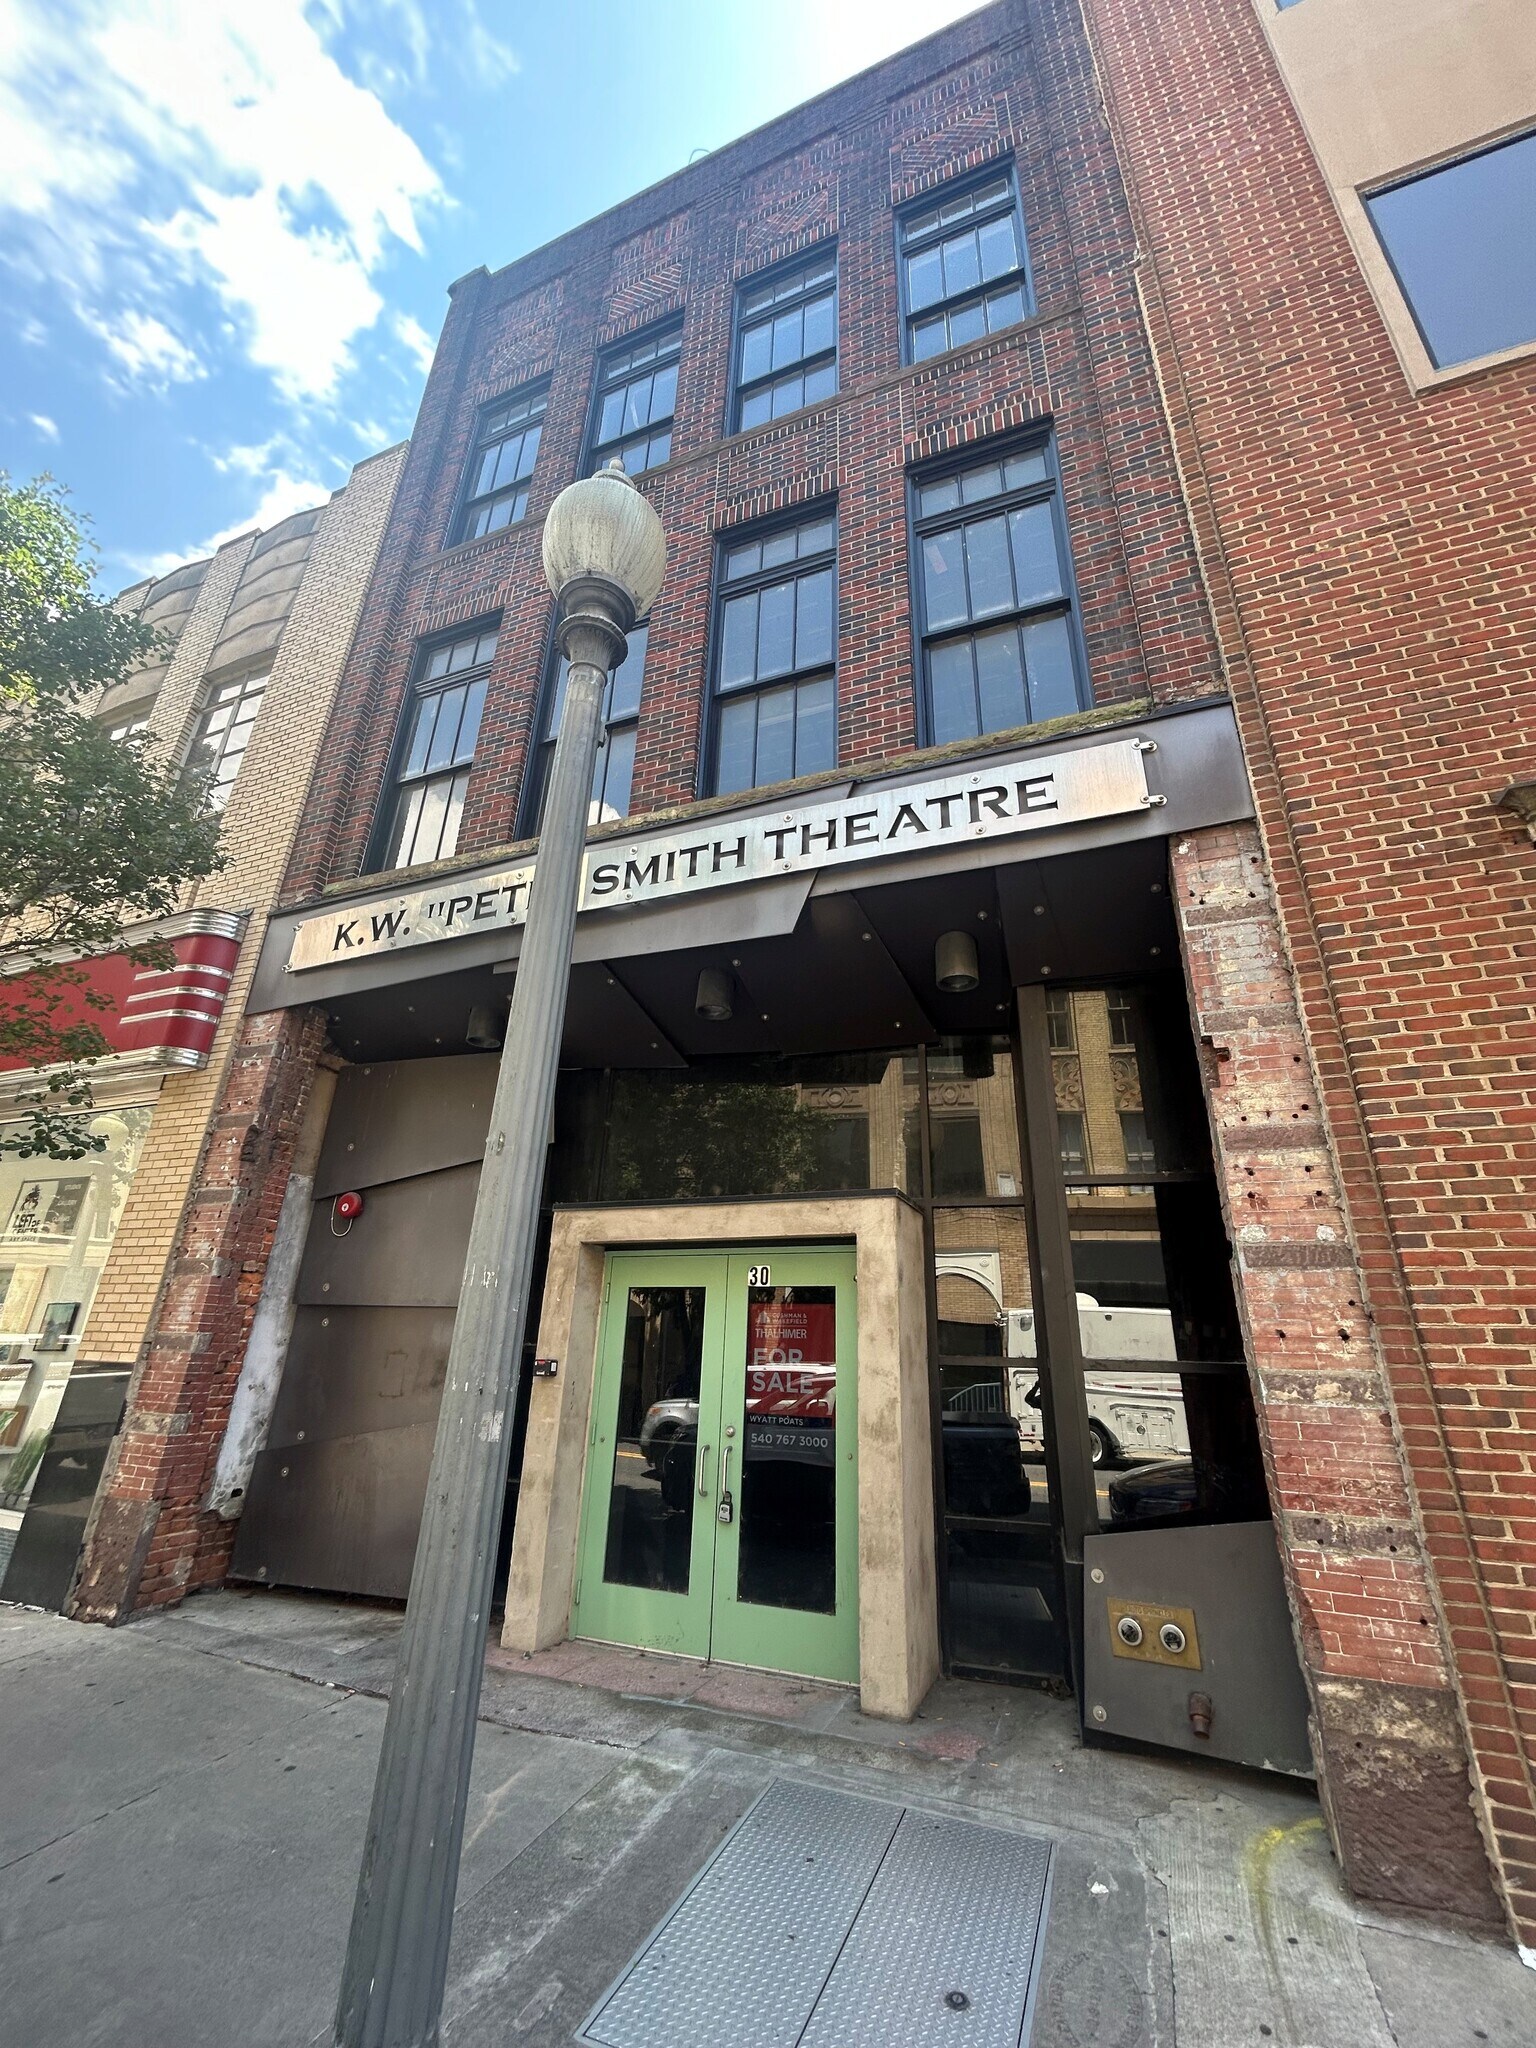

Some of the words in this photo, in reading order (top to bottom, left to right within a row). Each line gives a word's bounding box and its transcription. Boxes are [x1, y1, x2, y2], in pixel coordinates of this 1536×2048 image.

[425, 880, 534, 927] "PET
[590, 835, 747, 896] SMITH
[763, 771, 1059, 861] THEATRE
[749, 1266, 769, 1286] 30
[755, 1328, 808, 1339] THALHIMER
[753, 1347, 803, 1366] FOR
[752, 1371, 814, 1394] SALE
[749, 1415, 777, 1424] WYATT
[778, 1417, 804, 1426] POATS
[751, 1433, 773, 1444] 540
[776, 1434, 796, 1445] 767
[799, 1435, 829, 1448] 3000
